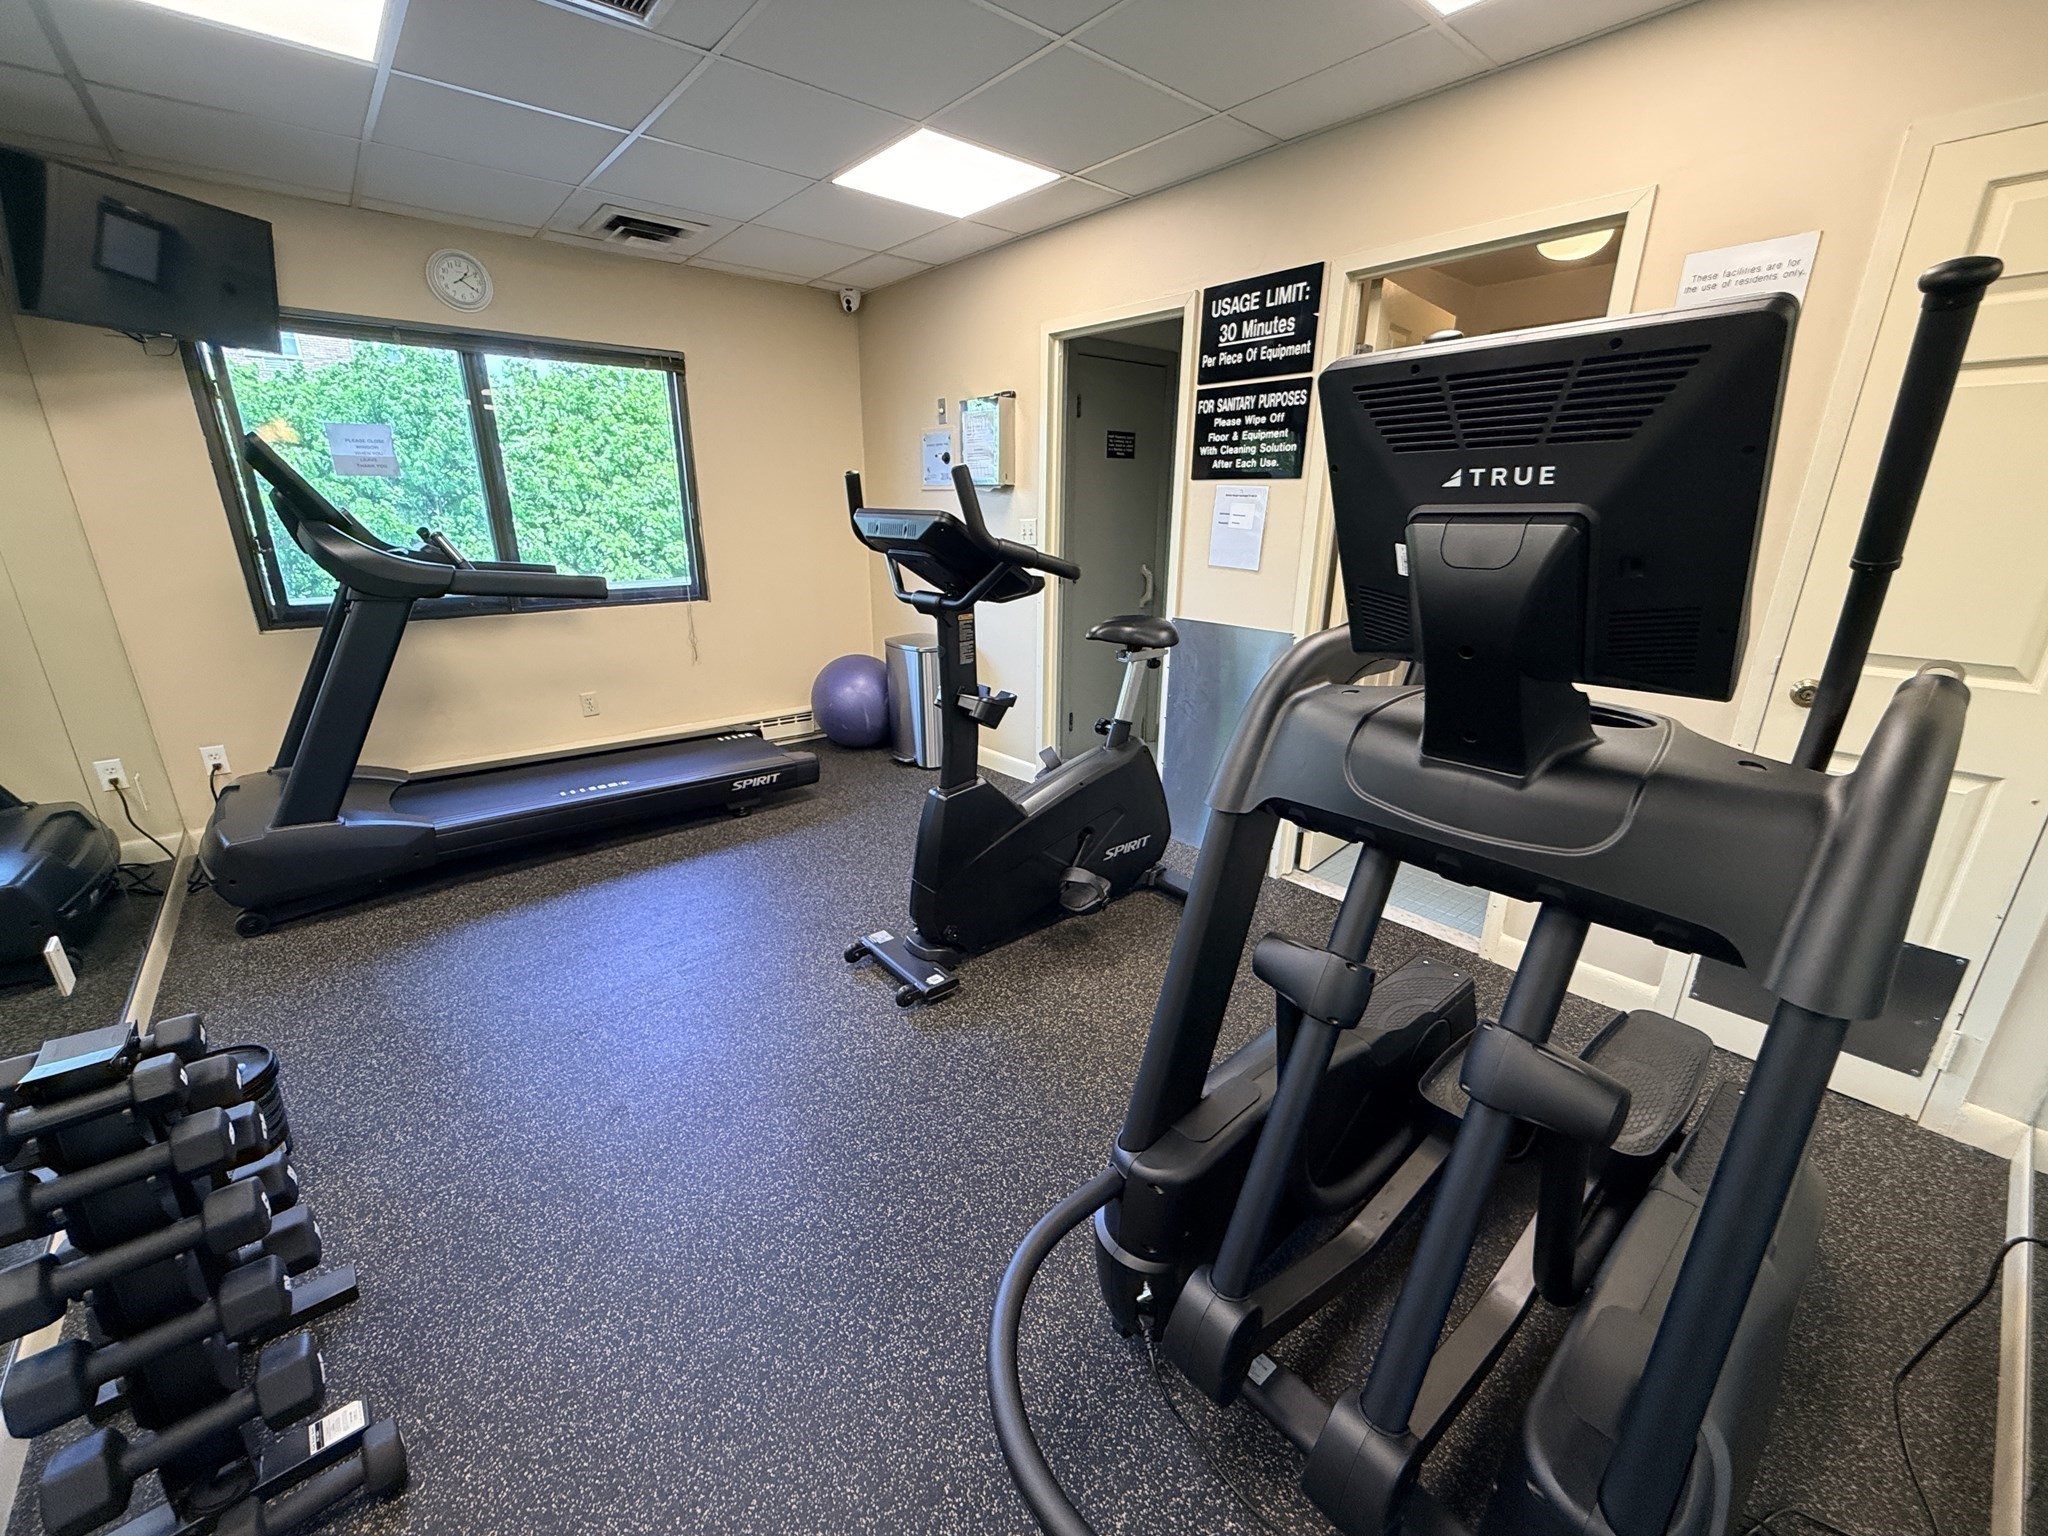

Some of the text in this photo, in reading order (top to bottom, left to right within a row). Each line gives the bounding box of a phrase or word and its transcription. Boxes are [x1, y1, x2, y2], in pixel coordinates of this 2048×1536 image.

[1692, 257, 1801, 284] These facilities are for
[1684, 284, 1698, 295] the
[1701, 282, 1718, 292] use
[1722, 278, 1731, 288] of
[1735, 274, 1777, 286] residents
[1211, 281, 1310, 318] USAGE LIMIT:
[1219, 316, 1296, 343] 30 Minutes
[1202, 340, 1311, 368] Per Piece Of Equipment
[1198, 389, 1308, 414] FOR SANITARY PURPOSES
[1213, 412, 1285, 427] Please Wipe Off
[1208, 428, 1289, 442] Floor & Equipment
[1200, 442, 1297, 456] With Cleaning Solution
[1212, 456, 1279, 469] After Each Use.
[1468, 465, 1557, 487] TRUE
[731, 772, 781, 792] SPIRIT
[1102, 834, 1152, 862] SPIRIT
